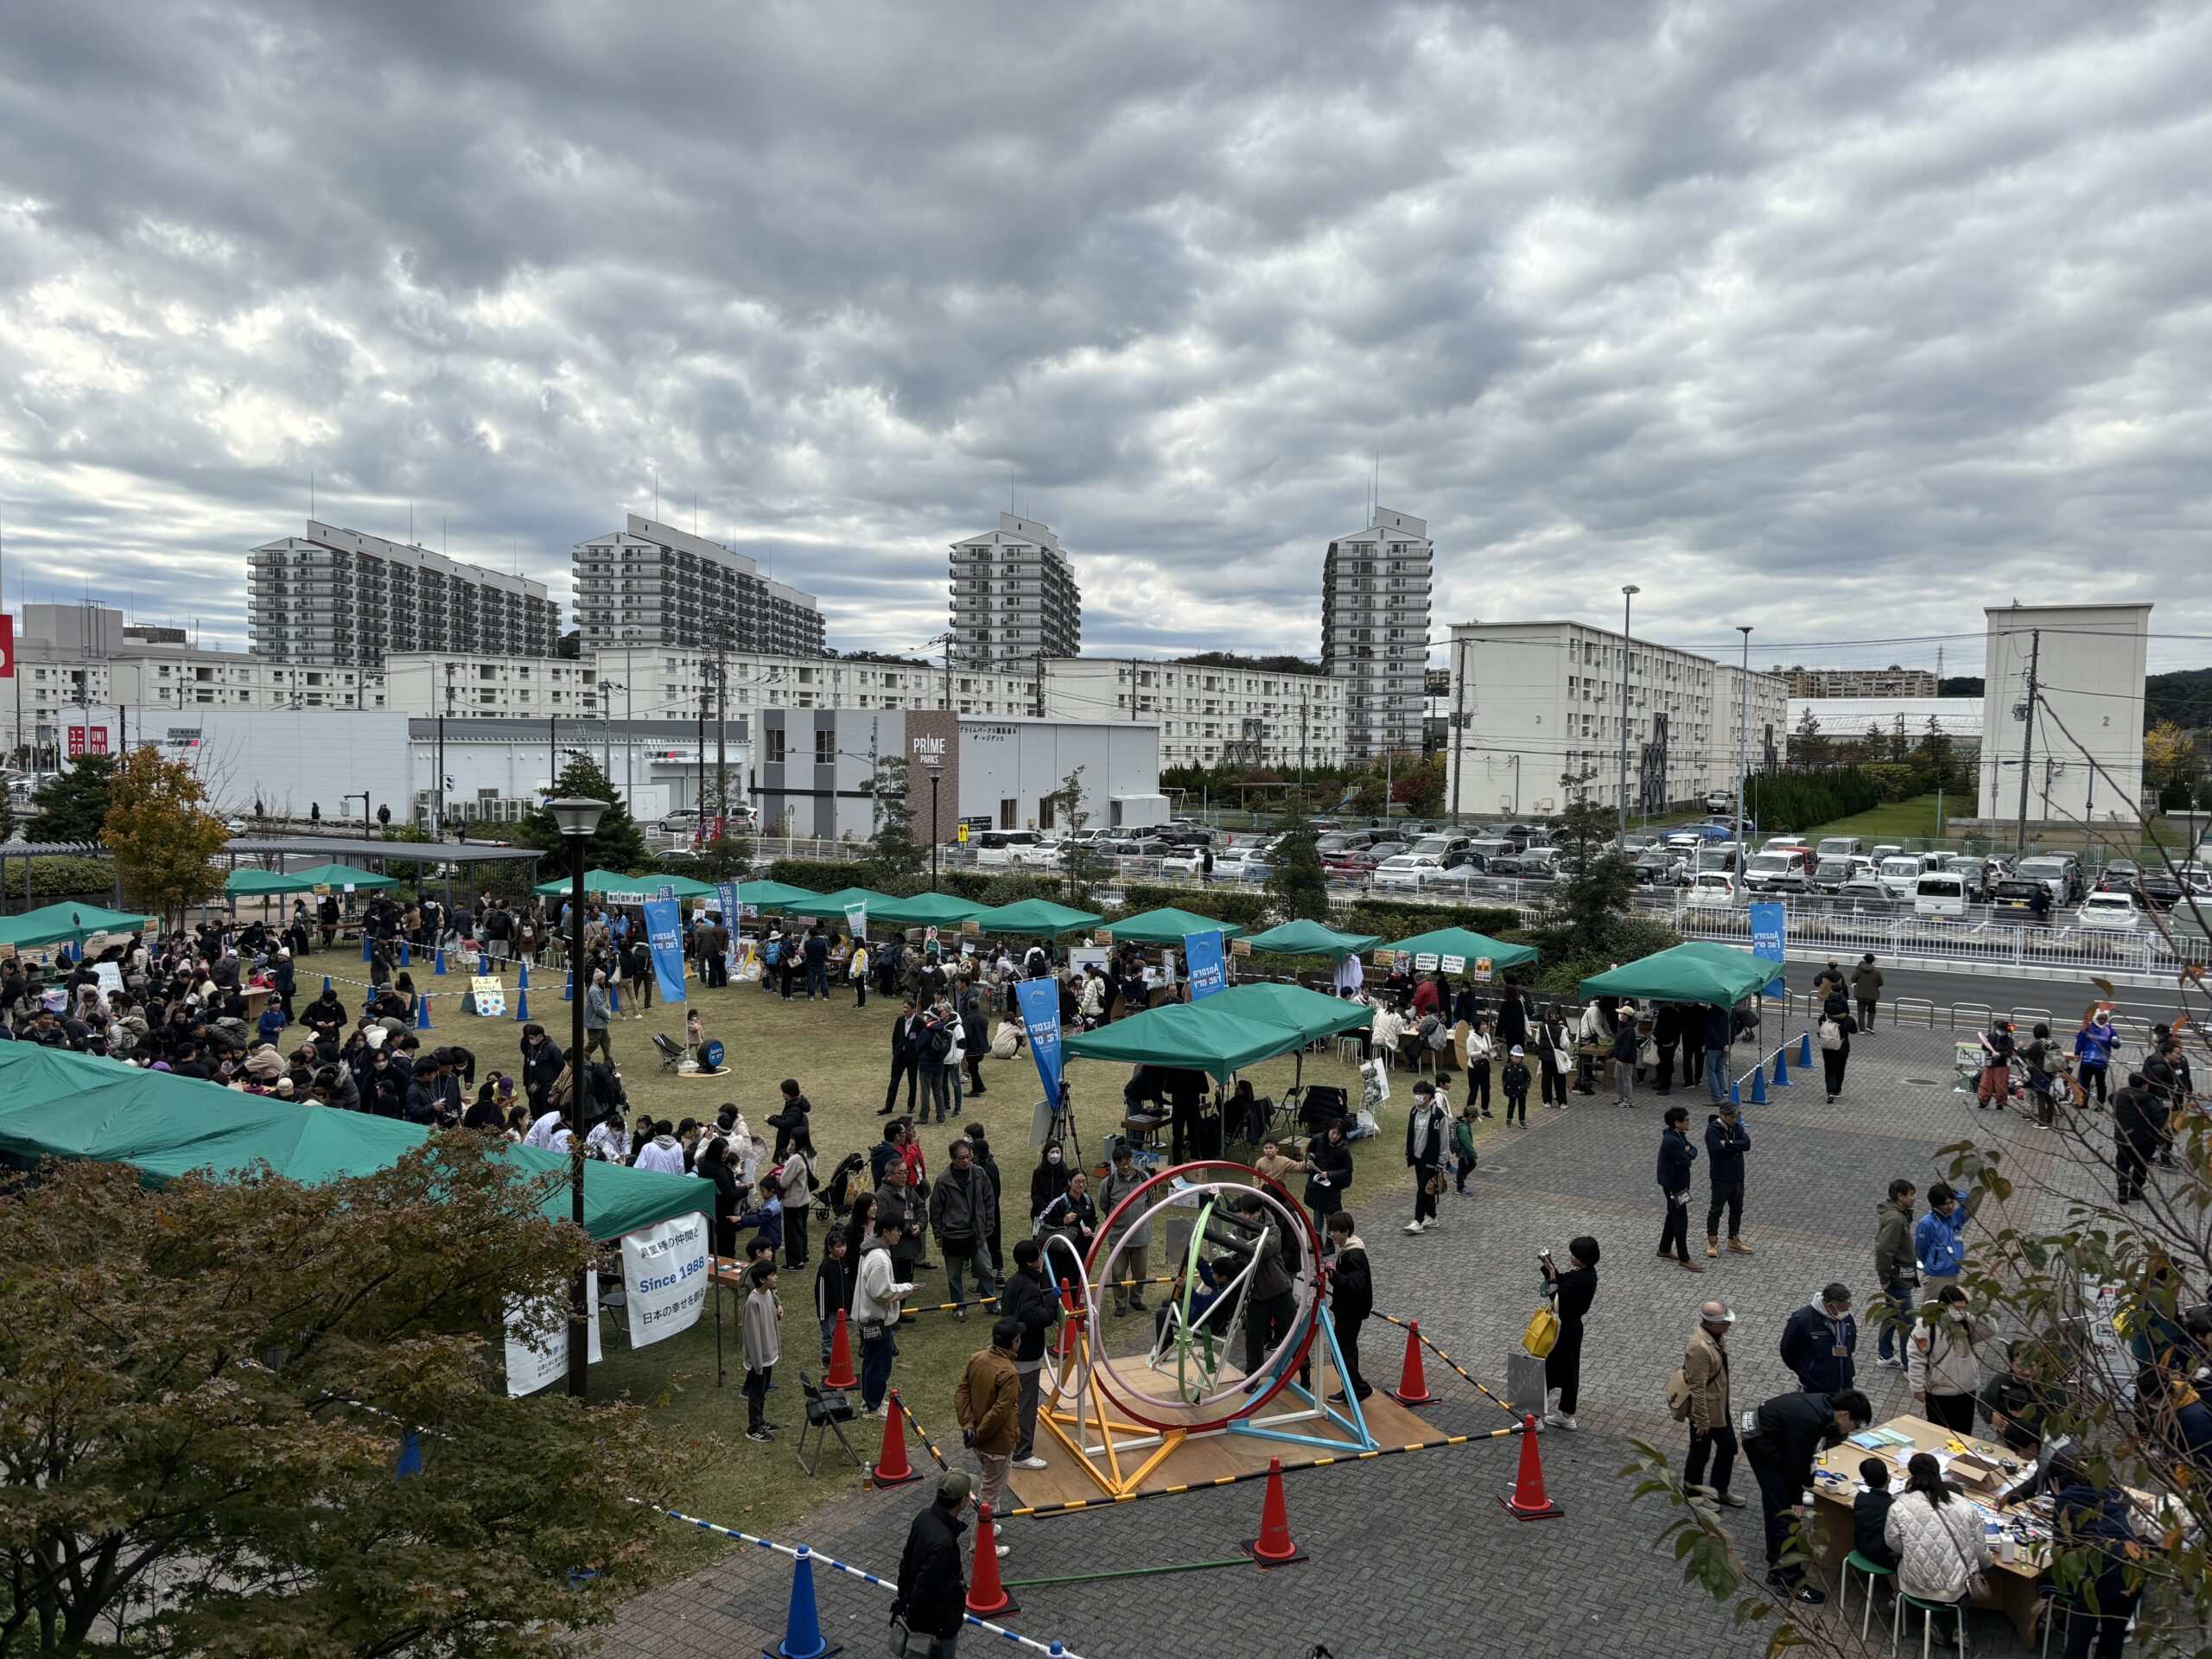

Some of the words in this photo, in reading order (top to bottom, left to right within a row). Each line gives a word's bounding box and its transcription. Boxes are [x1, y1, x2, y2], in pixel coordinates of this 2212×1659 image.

[1535, 715, 1541, 724] 3
[2102, 716, 2110, 726] 2
[70, 730, 83, 741] ユニ
[92, 730, 104, 742] UNI
[913, 733, 945, 753] PRIME
[920, 754, 938, 764] PARKS
[640, 1228, 699, 1259] 異業種の仲間と
[639, 1273, 677, 1294] Since
[679, 1255, 705, 1280] 1988
[643, 1287, 704, 1325] 日本の幸せを創る
